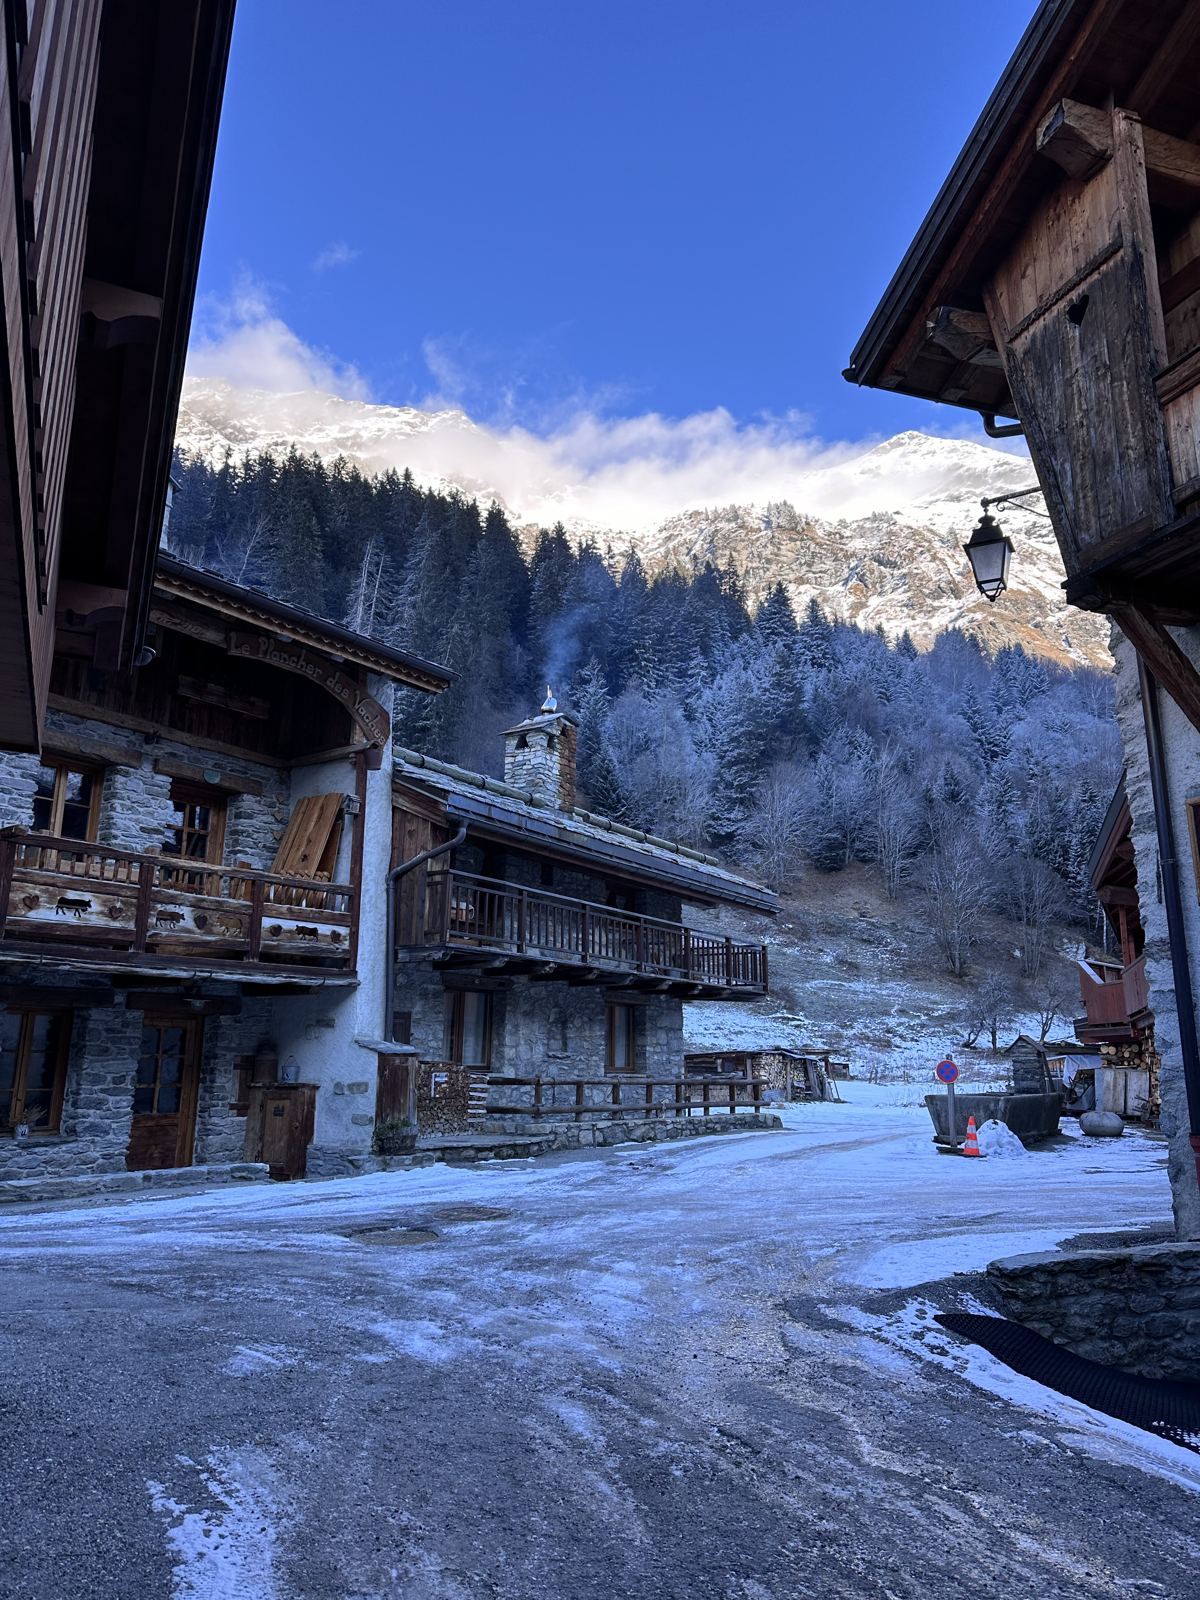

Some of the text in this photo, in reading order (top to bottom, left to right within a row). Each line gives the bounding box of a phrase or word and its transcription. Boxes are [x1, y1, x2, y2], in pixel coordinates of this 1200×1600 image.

[230, 631, 386, 745] Le Plancher des Vaches
